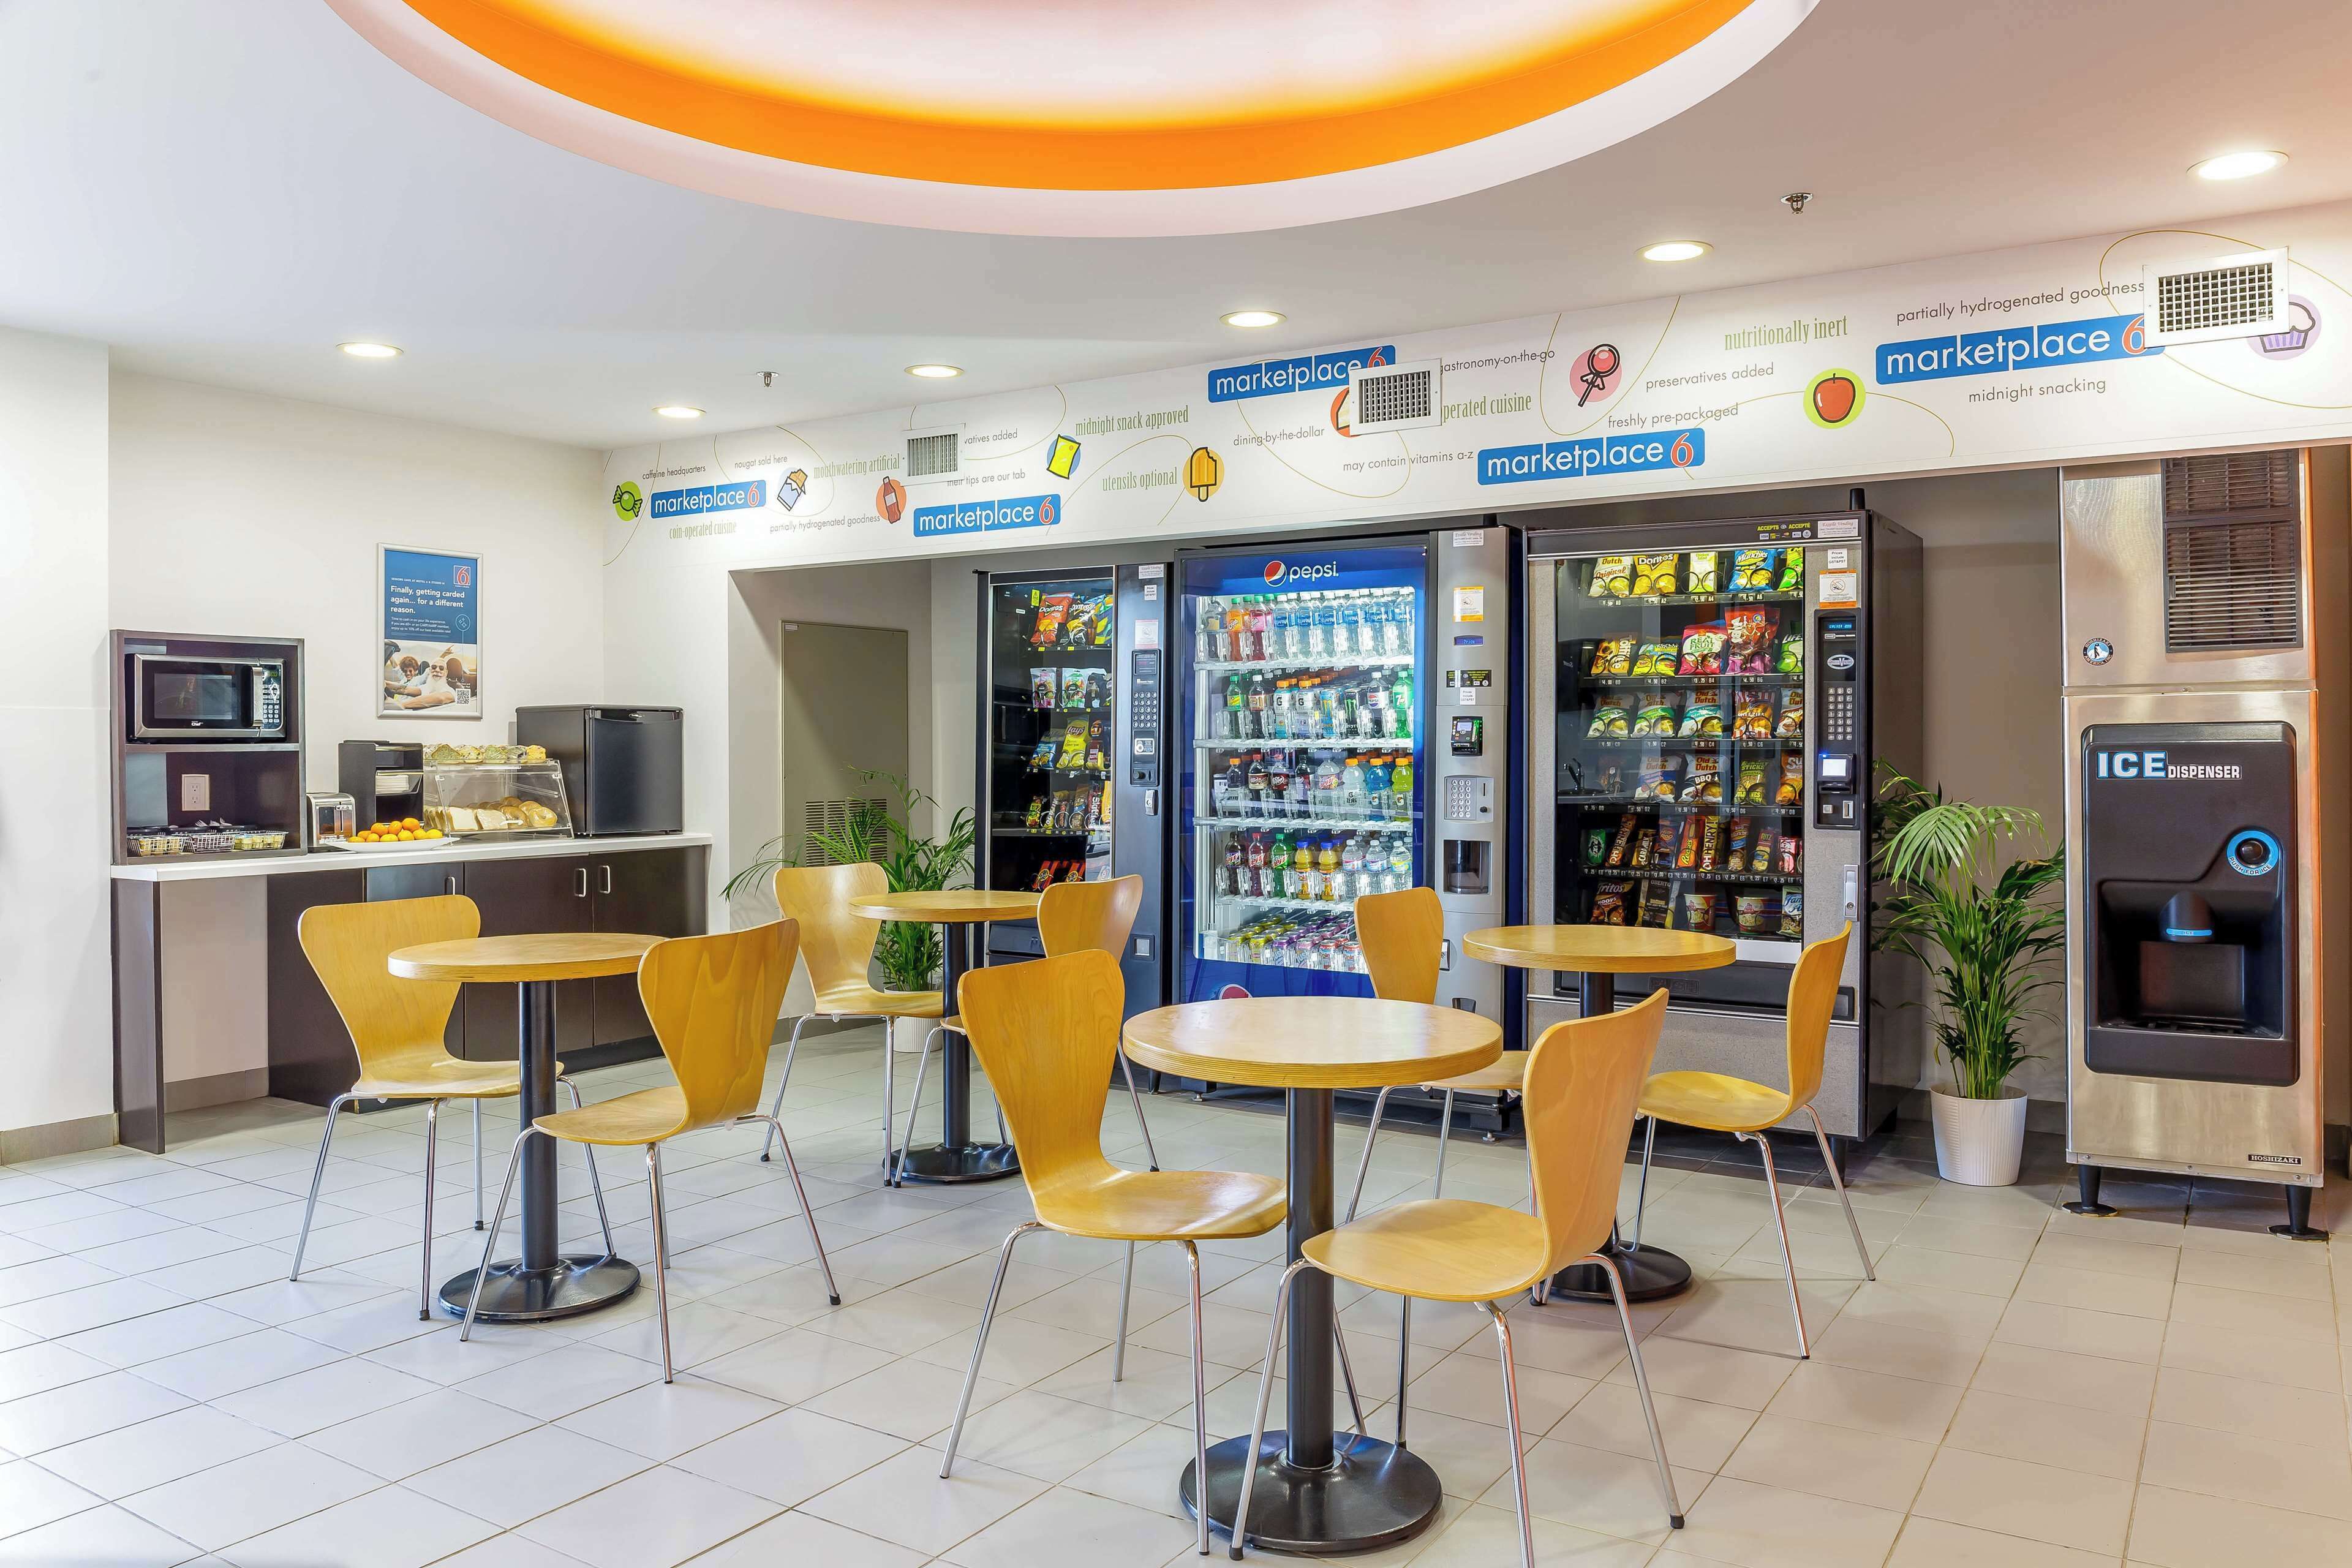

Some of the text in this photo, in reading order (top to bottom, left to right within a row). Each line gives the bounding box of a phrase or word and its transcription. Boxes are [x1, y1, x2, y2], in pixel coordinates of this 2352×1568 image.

[1896, 278, 2145, 325] partially hydrogenated goodness
[1725, 315, 1847, 351] nutritionally inert
[1887, 315, 2145, 374] marketplace 6
[1440, 349, 1556, 373] gastronomy-on-the-go
[1216, 355, 1362, 395] marketplace
[1646, 362, 1774, 391] preservatives added
[1969, 377, 2107, 404] midnight snacking
[1490, 393, 1532, 416] cuisine
[1076, 405, 1189, 436] midnight snack approved
[1608, 403, 1738, 429] freshly pre-packaged
[992, 429, 1017, 442] added
[1234, 426, 1325, 447] dining-by-the-dollar
[735, 455, 788, 469] nougat sold here
[1343, 451, 1473, 473] may contain vitamins a-z
[1488, 433, 1693, 477] marketplace 6
[643, 465, 706, 480] caffeine headquarters
[814, 453, 900, 479] mouthwatering artificial
[966, 474, 979, 488] tips
[997, 473, 1010, 482] our
[1012, 469, 1025, 480] tab
[1103, 467, 1177, 491] utensils optional
[655, 481, 760, 514] marketplace 6
[771, 514, 880, 534] partially hydrogenated goodness
[919, 496, 1054, 532] marketplace 6
[669, 521, 737, 539] coin-operated cuisine
[1638, 554, 1673, 565] Doritos
[1736, 551, 1768, 563] Munchies
[457, 567, 470, 585] 6
[1596, 567, 1626, 580] Original
[391, 586, 413, 595] Finally,
[1229, 619, 1238, 629] Crush
[1276, 697, 1283, 706] G
[2097, 751, 2241, 779] ICE DISPENSER
[1695, 775, 1711, 783] BBQ
[1760, 832, 1772, 841] RITZ
[1638, 837, 1650, 861] CARAMILK
[1681, 840, 1693, 864] Reese's
[2230, 857, 2244, 872] PUSH
[2261, 864, 2272, 873] ICE
[1597, 883, 1623, 894] Fritos
[2250, 1155, 2299, 1164] HOSHIZAKI
